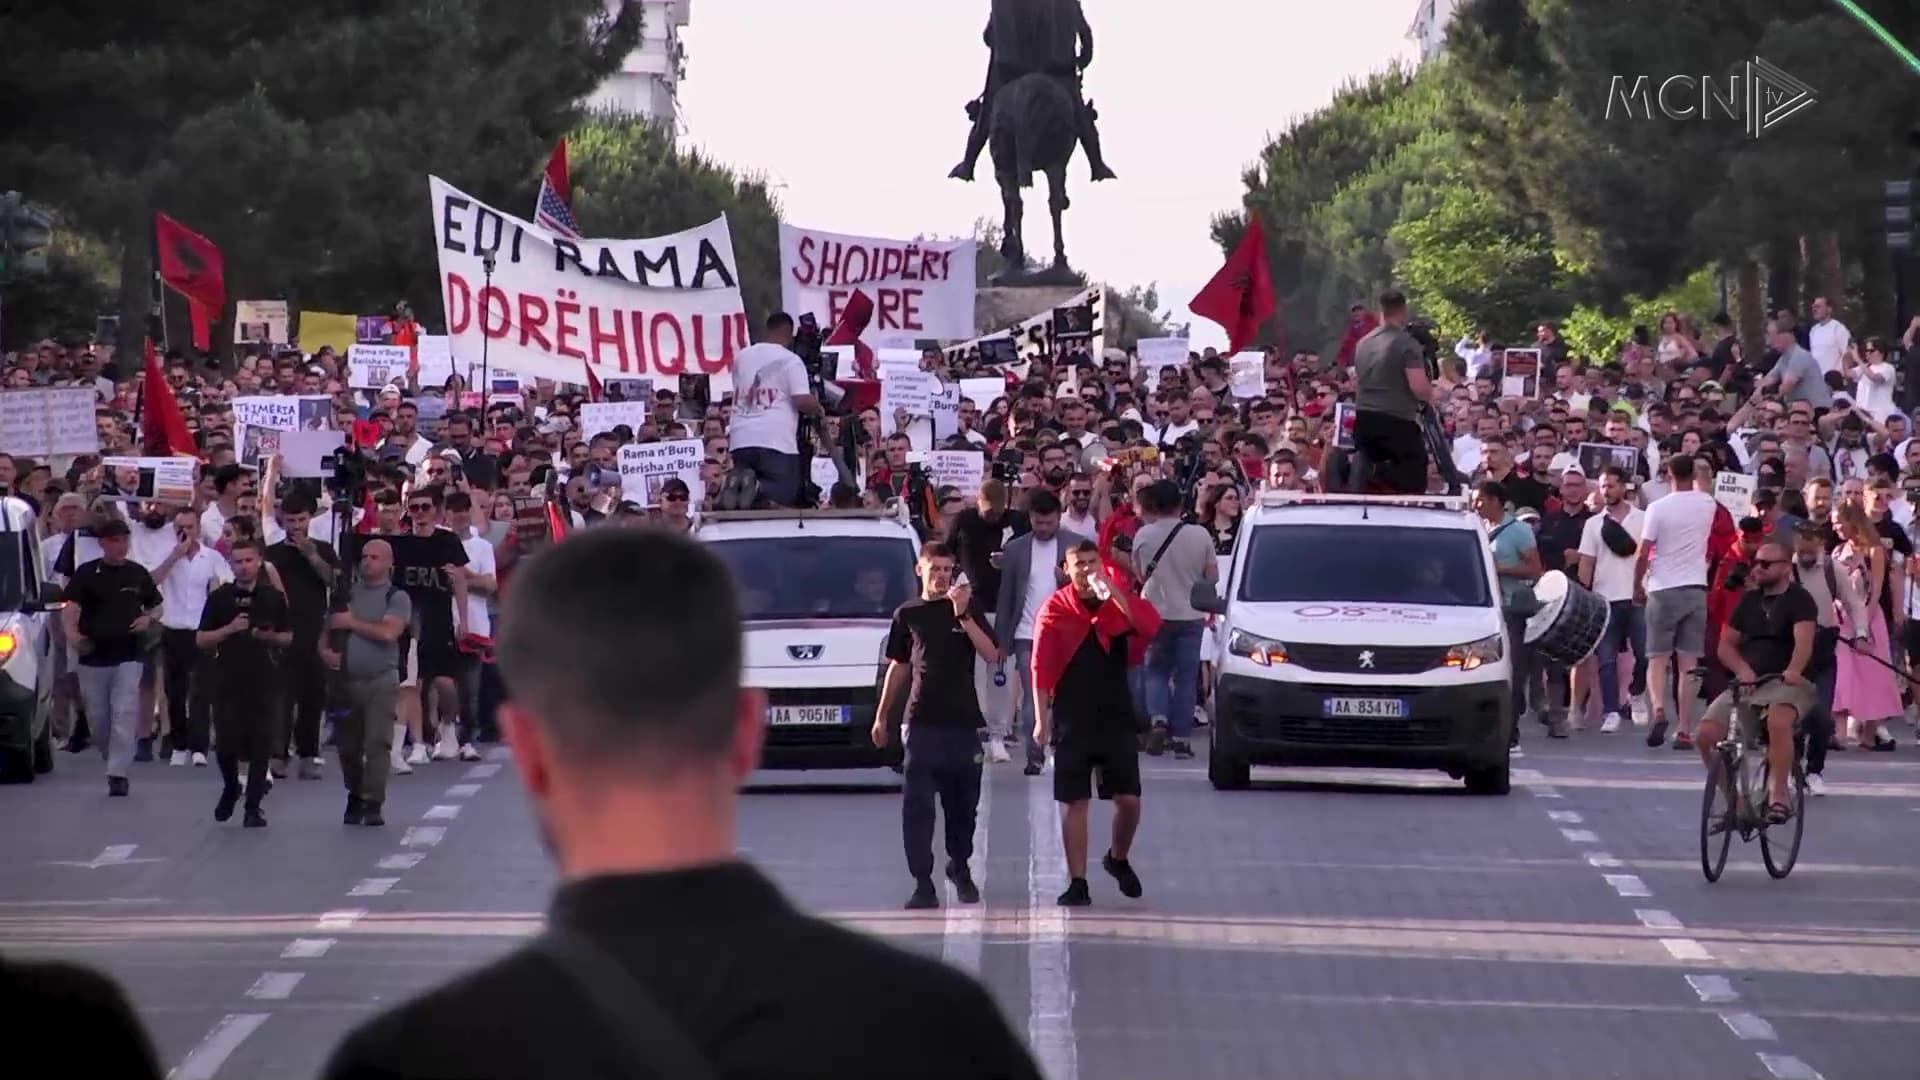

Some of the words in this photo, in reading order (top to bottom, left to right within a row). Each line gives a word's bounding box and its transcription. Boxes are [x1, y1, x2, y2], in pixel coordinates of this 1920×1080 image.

[444, 195, 524, 263] EDI
[552, 237, 737, 288] RAMA
[623, 448, 655, 460] Rama
[657, 445, 696, 457] n'Burg
[621, 461, 664, 475] Berisha
[1335, 700, 1351, 713] AA
[775, 708, 791, 722] AA
